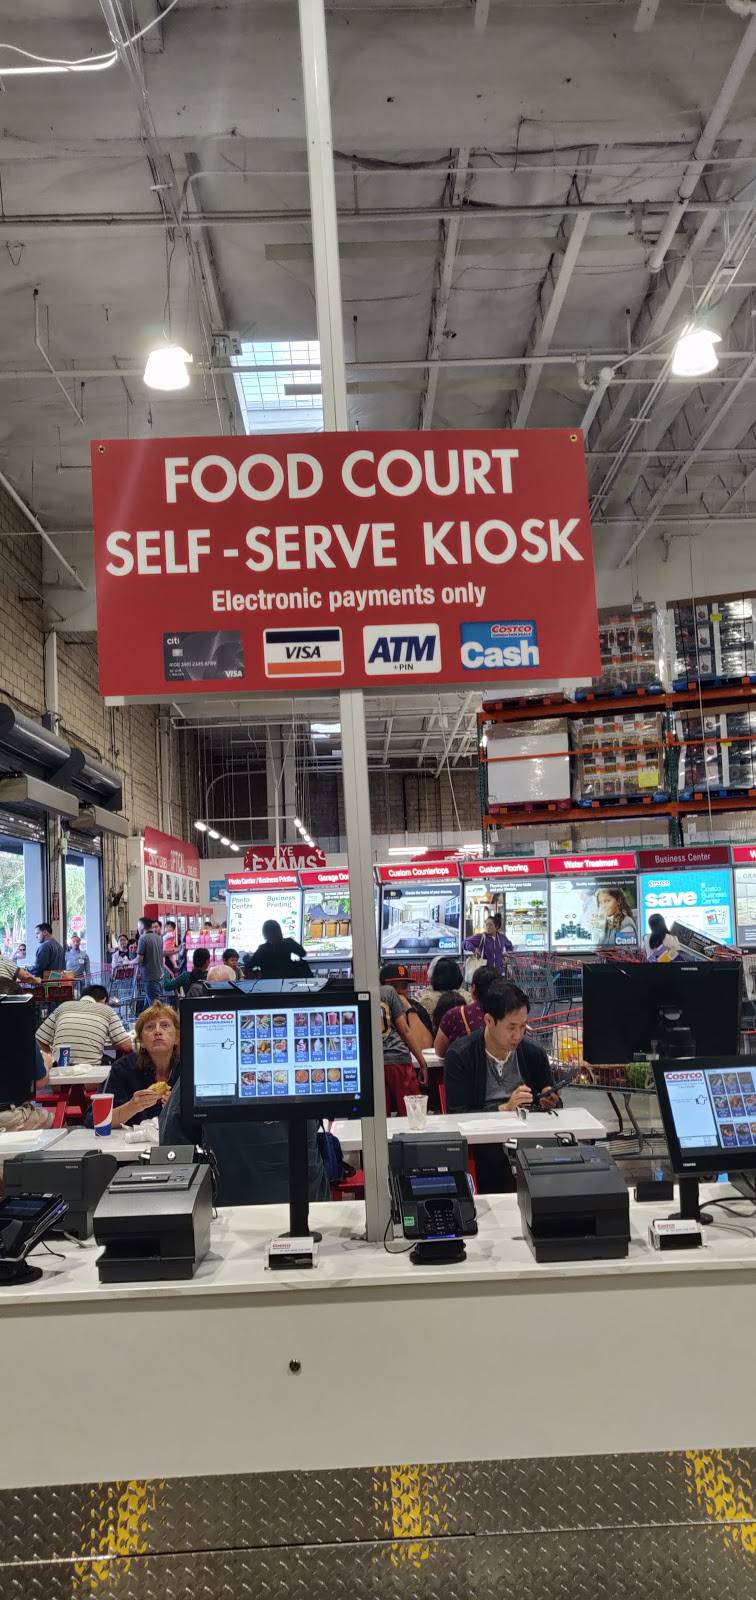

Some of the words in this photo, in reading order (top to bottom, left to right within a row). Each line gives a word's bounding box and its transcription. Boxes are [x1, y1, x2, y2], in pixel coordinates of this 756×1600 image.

[164, 453, 324, 504] FOOD
[341, 448, 520, 498] COURT
[423, 517, 584, 566] KIOSK
[212, 587, 323, 613] Electronic
[329, 583, 435, 612] payments
[441, 582, 487, 607] only
[491, 624, 532, 634] COSTCO
[166, 637, 180, 645] citi
[285, 646, 321, 659] VISA
[368, 635, 436, 664] ATM
[460, 639, 540, 669] Cash
[224, 670, 243, 678] VISA
[252, 855, 317, 872] EXAMS
[563, 860, 584, 868] Water
[584, 859, 618, 868] Treatment
[655, 854, 686, 864] Business
[688, 852, 711, 862] Center
[388, 869, 412, 877] Custom
[412, 867, 449, 878] Countertops
[479, 866, 502, 874] Custom
[503, 864, 529, 874] Flooring
[317, 874, 338, 883] Garage
[645, 891, 698, 907] save
[615, 936, 637, 945] Cash
[194, 1013, 234, 1021] COSTCO
[665, 1072, 702, 1080] COSTCO
